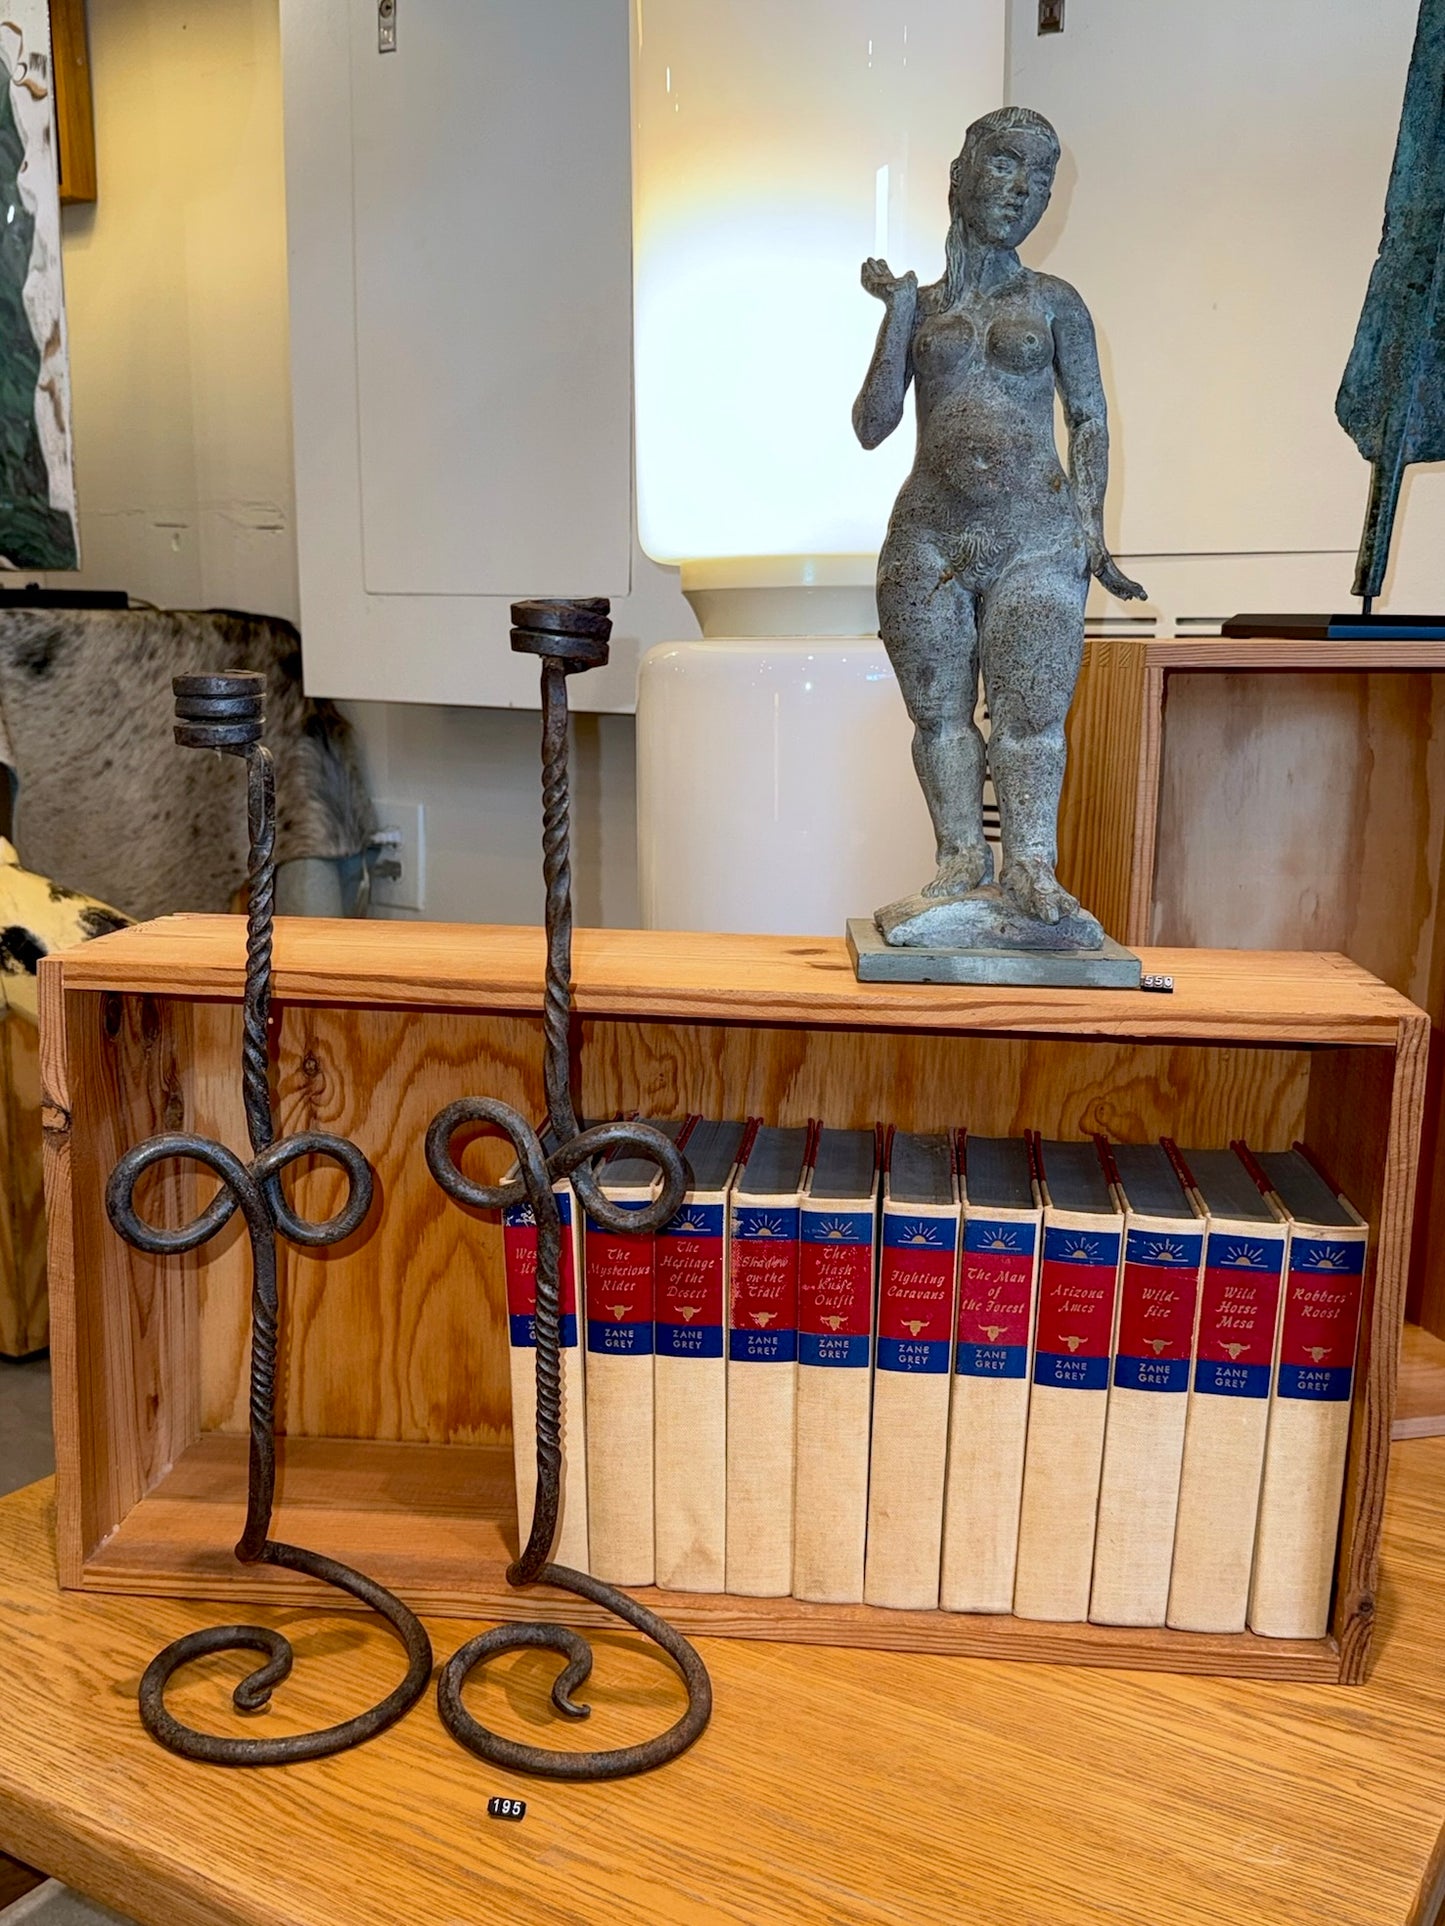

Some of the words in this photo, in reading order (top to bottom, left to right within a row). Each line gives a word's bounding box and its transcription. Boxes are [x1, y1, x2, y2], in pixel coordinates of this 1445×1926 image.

[1144, 975, 1173, 987] 550
[677, 1241, 700, 1253] The
[823, 1246, 846, 1259] The
[607, 1248, 631, 1260] The
[660, 1255, 715, 1271] Heritage
[741, 1256, 789, 1269] Shadow
[588, 1263, 650, 1277] Mysterious
[817, 1264, 853, 1276] Hash
[967, 1267, 992, 1281] The
[993, 1270, 1026, 1283] Man
[670, 1272, 681, 1285] of
[684, 1272, 704, 1283] the
[746, 1274, 762, 1283] on
[764, 1272, 786, 1283] the
[891, 1270, 946, 1288] Fighting
[601, 1280, 636, 1292] Rider
[748, 1285, 781, 1299] Trail
[817, 1279, 853, 1293] Knife
[1050, 1284, 1104, 1299] Arizona
[666, 1286, 708, 1299] Desert
[887, 1286, 946, 1300] Caravans
[987, 1286, 1002, 1300] of
[1142, 1287, 1180, 1303] Wild-
[1224, 1286, 1257, 1300] Wild
[815, 1294, 855, 1308] Outfit
[962, 1299, 983, 1311] the
[985, 1300, 1025, 1314] Forest
[1058, 1300, 1095, 1314] Ames
[1143, 1304, 1171, 1318] fire
[1215, 1301, 1258, 1315] Horse
[1301, 1305, 1341, 1319] Roost
[1216, 1315, 1254, 1329] Mesa
[605, 1328, 634, 1338] ZANE
[673, 1330, 703, 1339] ZANE
[605, 1339, 634, 1348] GREY
[673, 1339, 702, 1349] GREY
[748, 1336, 778, 1345] ZANE
[819, 1339, 849, 1349] ZANE
[748, 1346, 778, 1356] GREY
[819, 1349, 848, 1359] GREY
[899, 1344, 930, 1354] ZANE
[975, 1349, 1007, 1359] ZANE
[898, 1354, 928, 1365] GREY
[975, 1359, 1006, 1370] GREY
[1055, 1360, 1087, 1370] ZANE
[1139, 1363, 1171, 1374] ZANE
[1216, 1367, 1248, 1378] ZANE
[1055, 1370, 1086, 1381] GREY
[1138, 1373, 1169, 1384] GREY
[1298, 1370, 1331, 1381] ZANE
[1215, 1377, 1246, 1389] GREY
[1297, 1381, 1329, 1392] GREY
[493, 1798, 521, 1815] 195
